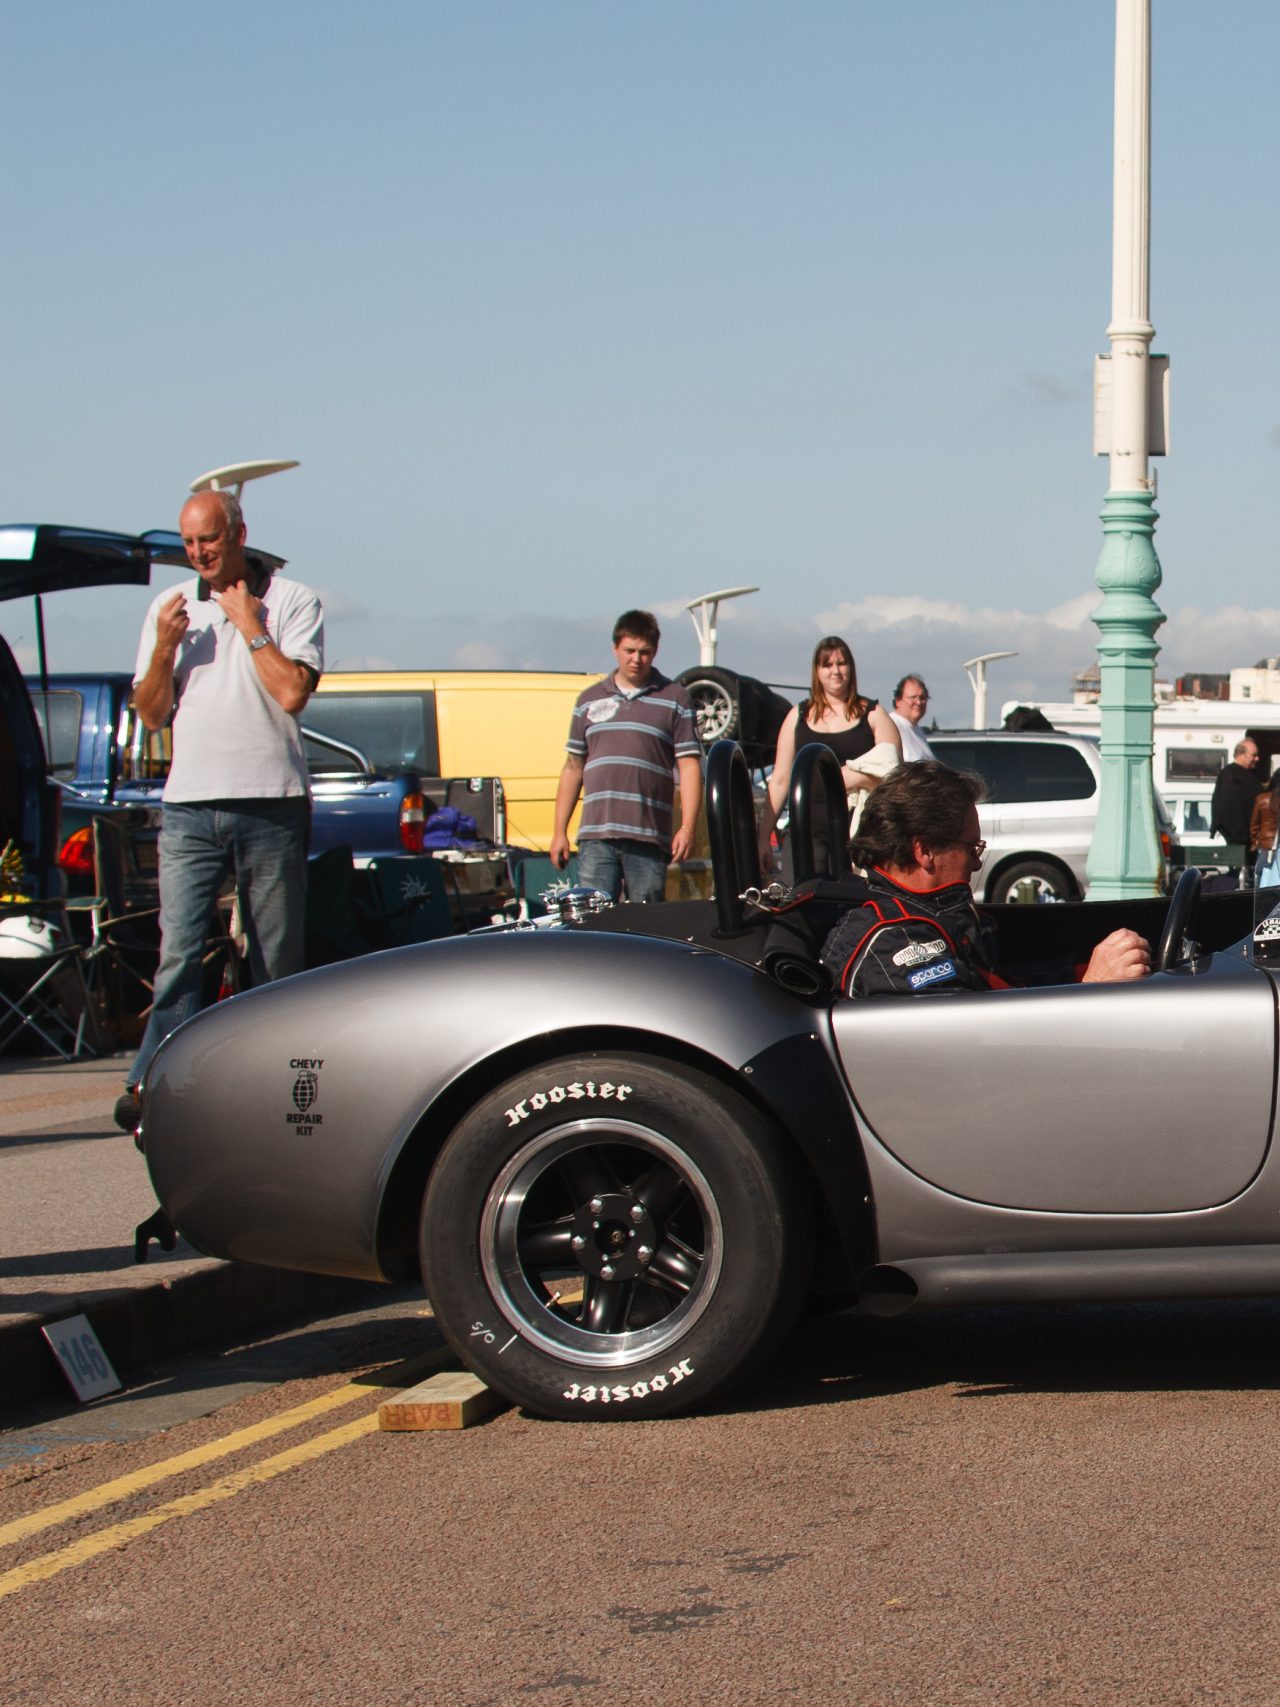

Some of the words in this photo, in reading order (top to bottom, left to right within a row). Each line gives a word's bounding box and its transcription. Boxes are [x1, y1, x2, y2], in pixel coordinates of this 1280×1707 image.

[289, 1058, 324, 1069] CHEVY
[286, 1113, 323, 1124] REPAIR
[504, 1081, 633, 1128] Hoosier
[296, 1126, 314, 1136] KIT
[60, 1333, 109, 1386] 146
[563, 1357, 694, 1404] Hoosier
